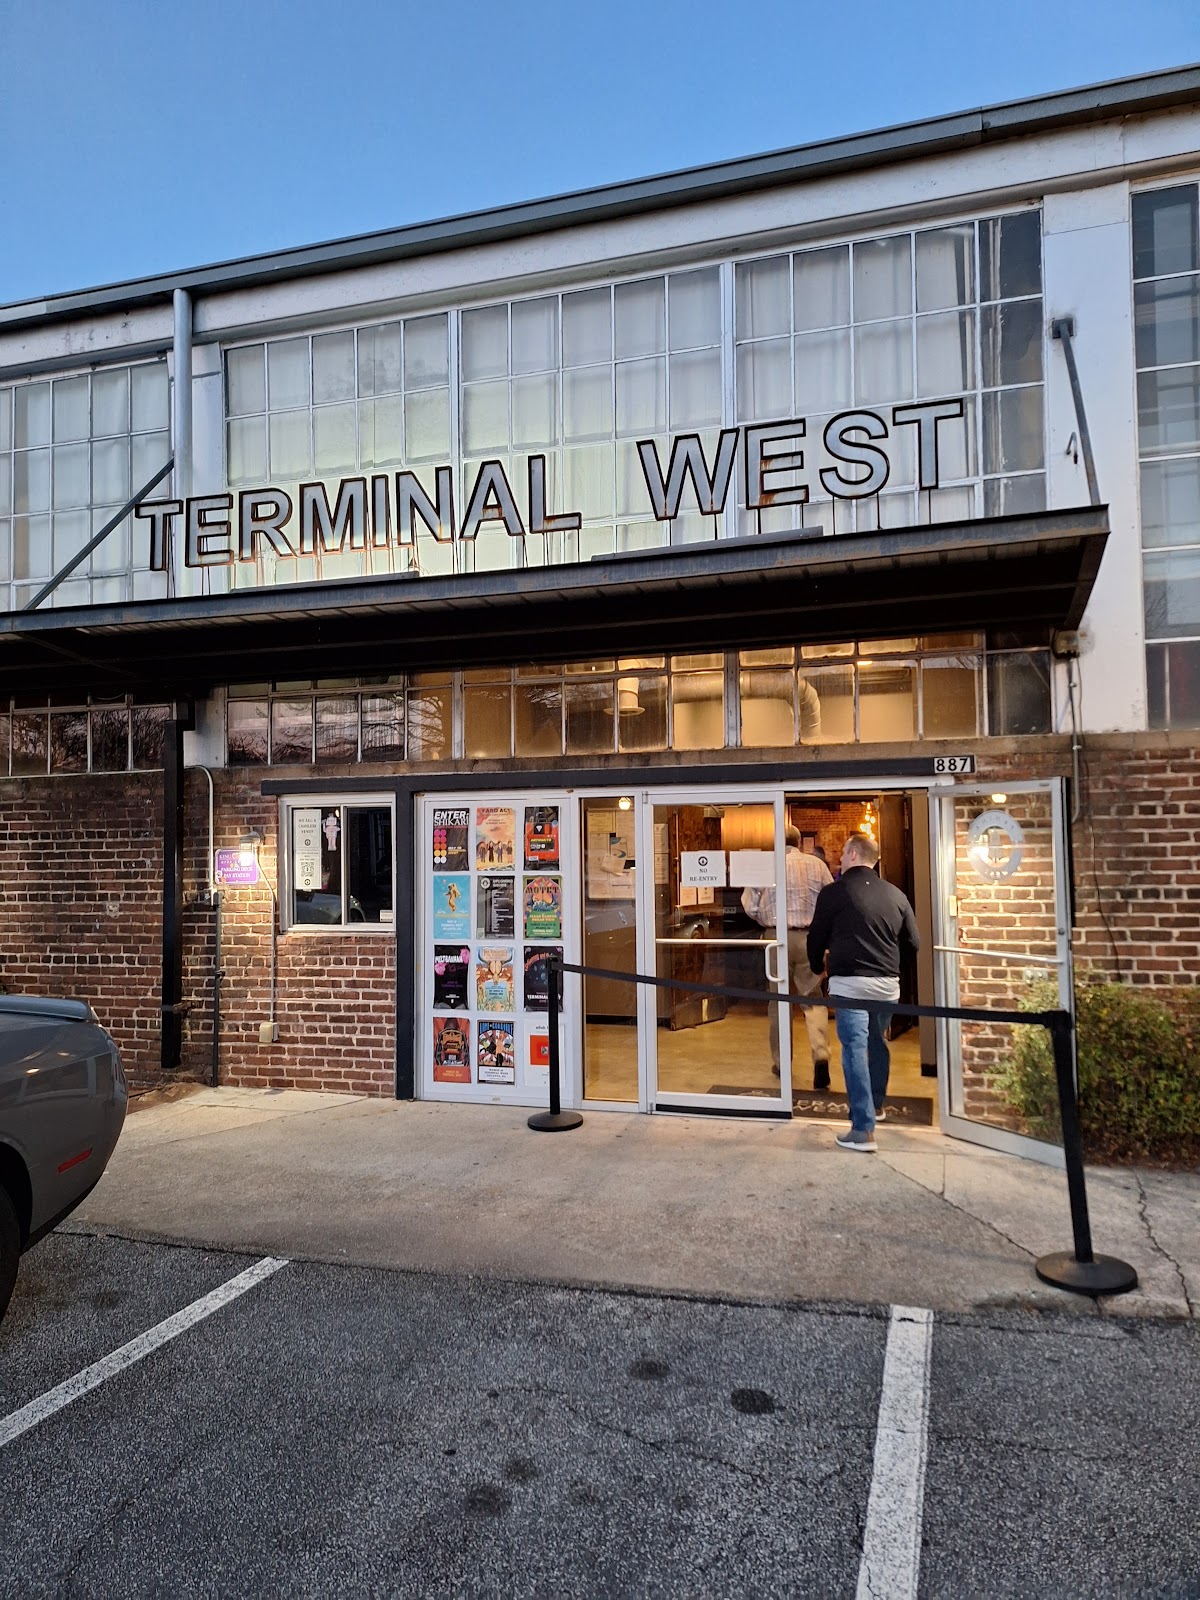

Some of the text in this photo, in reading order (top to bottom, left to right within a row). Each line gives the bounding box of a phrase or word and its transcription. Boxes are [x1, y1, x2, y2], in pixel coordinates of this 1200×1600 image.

[134, 397, 964, 572] TERMINAL WEST
[936, 758, 969, 772] 887
[433, 818, 469, 826] SHIKARI
[525, 886, 559, 894] MOTET
